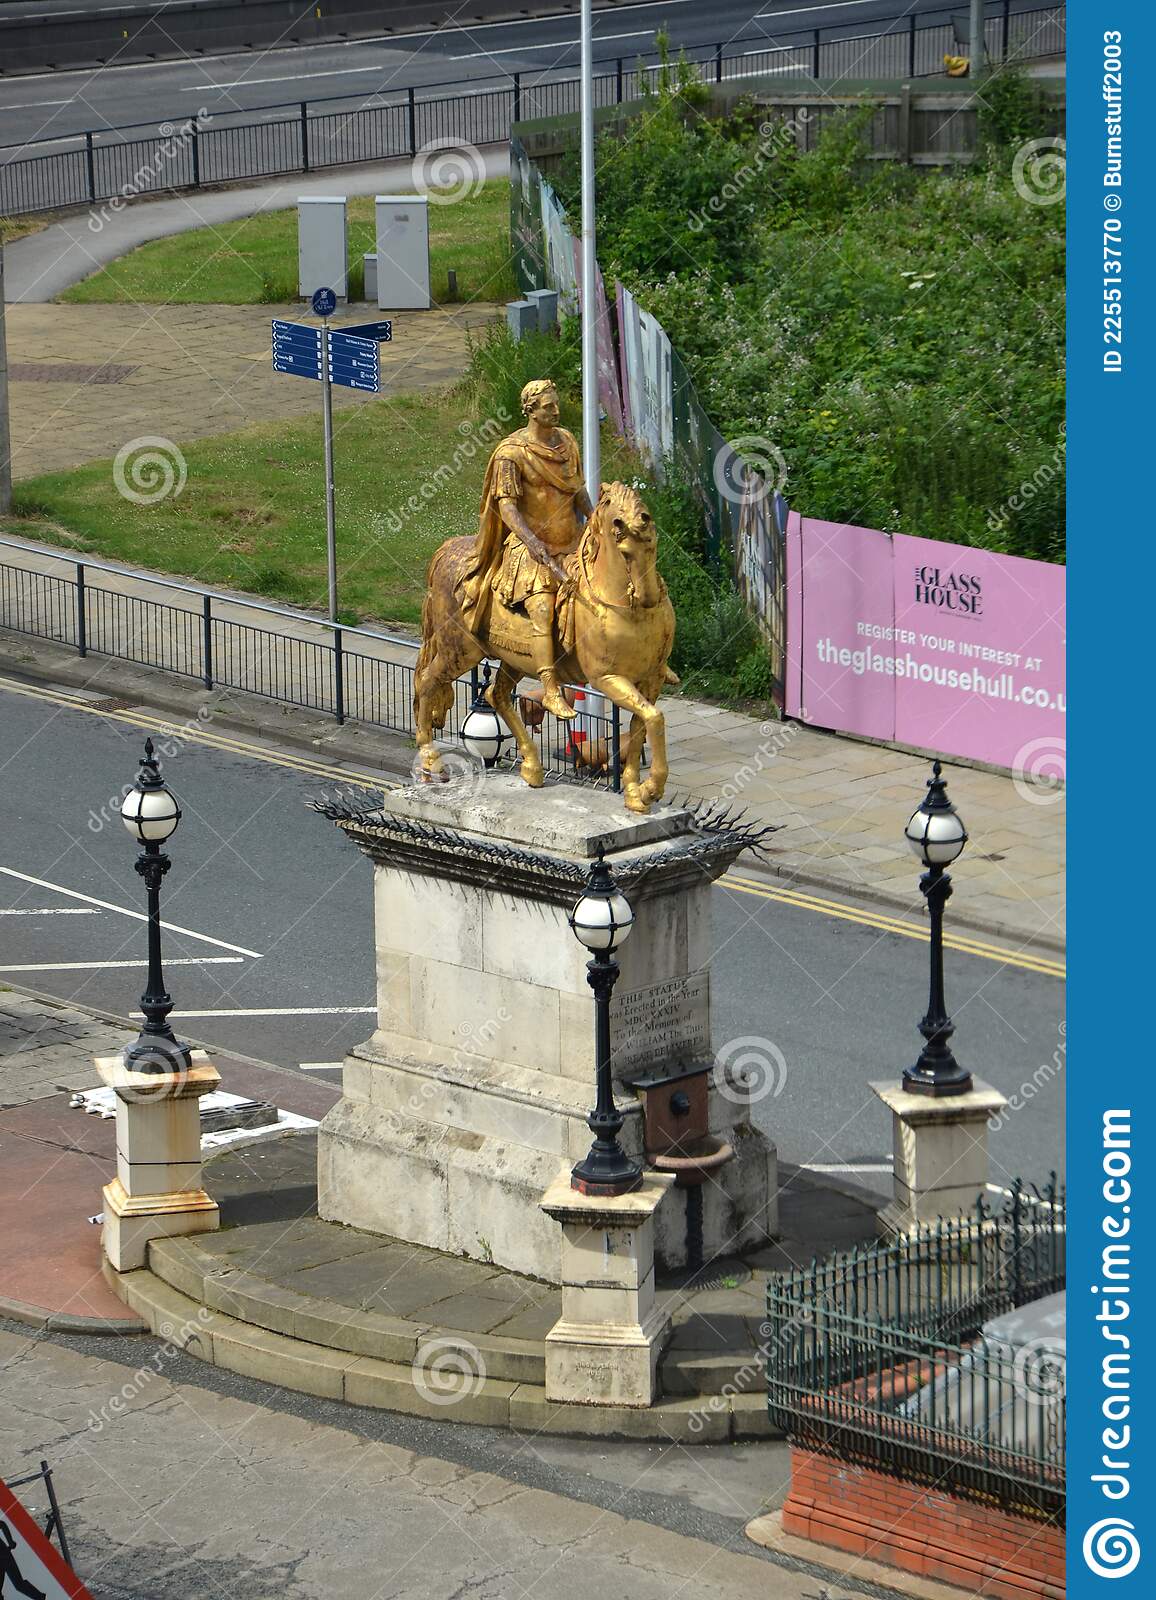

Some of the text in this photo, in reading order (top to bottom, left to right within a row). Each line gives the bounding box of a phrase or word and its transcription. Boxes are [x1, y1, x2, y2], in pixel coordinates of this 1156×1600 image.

[920, 566, 981, 595] GLASS
[915, 584, 983, 615] HOUSE
[857, 622, 1043, 671] REGISTER YOUR INTEREST AT
[619, 980, 688, 1006] THIS STATUE
[624, 998, 656, 1016] Erected
[658, 999, 667, 1007] in
[681, 988, 700, 999] Year
[614, 1009, 694, 1041] To the Memory of
